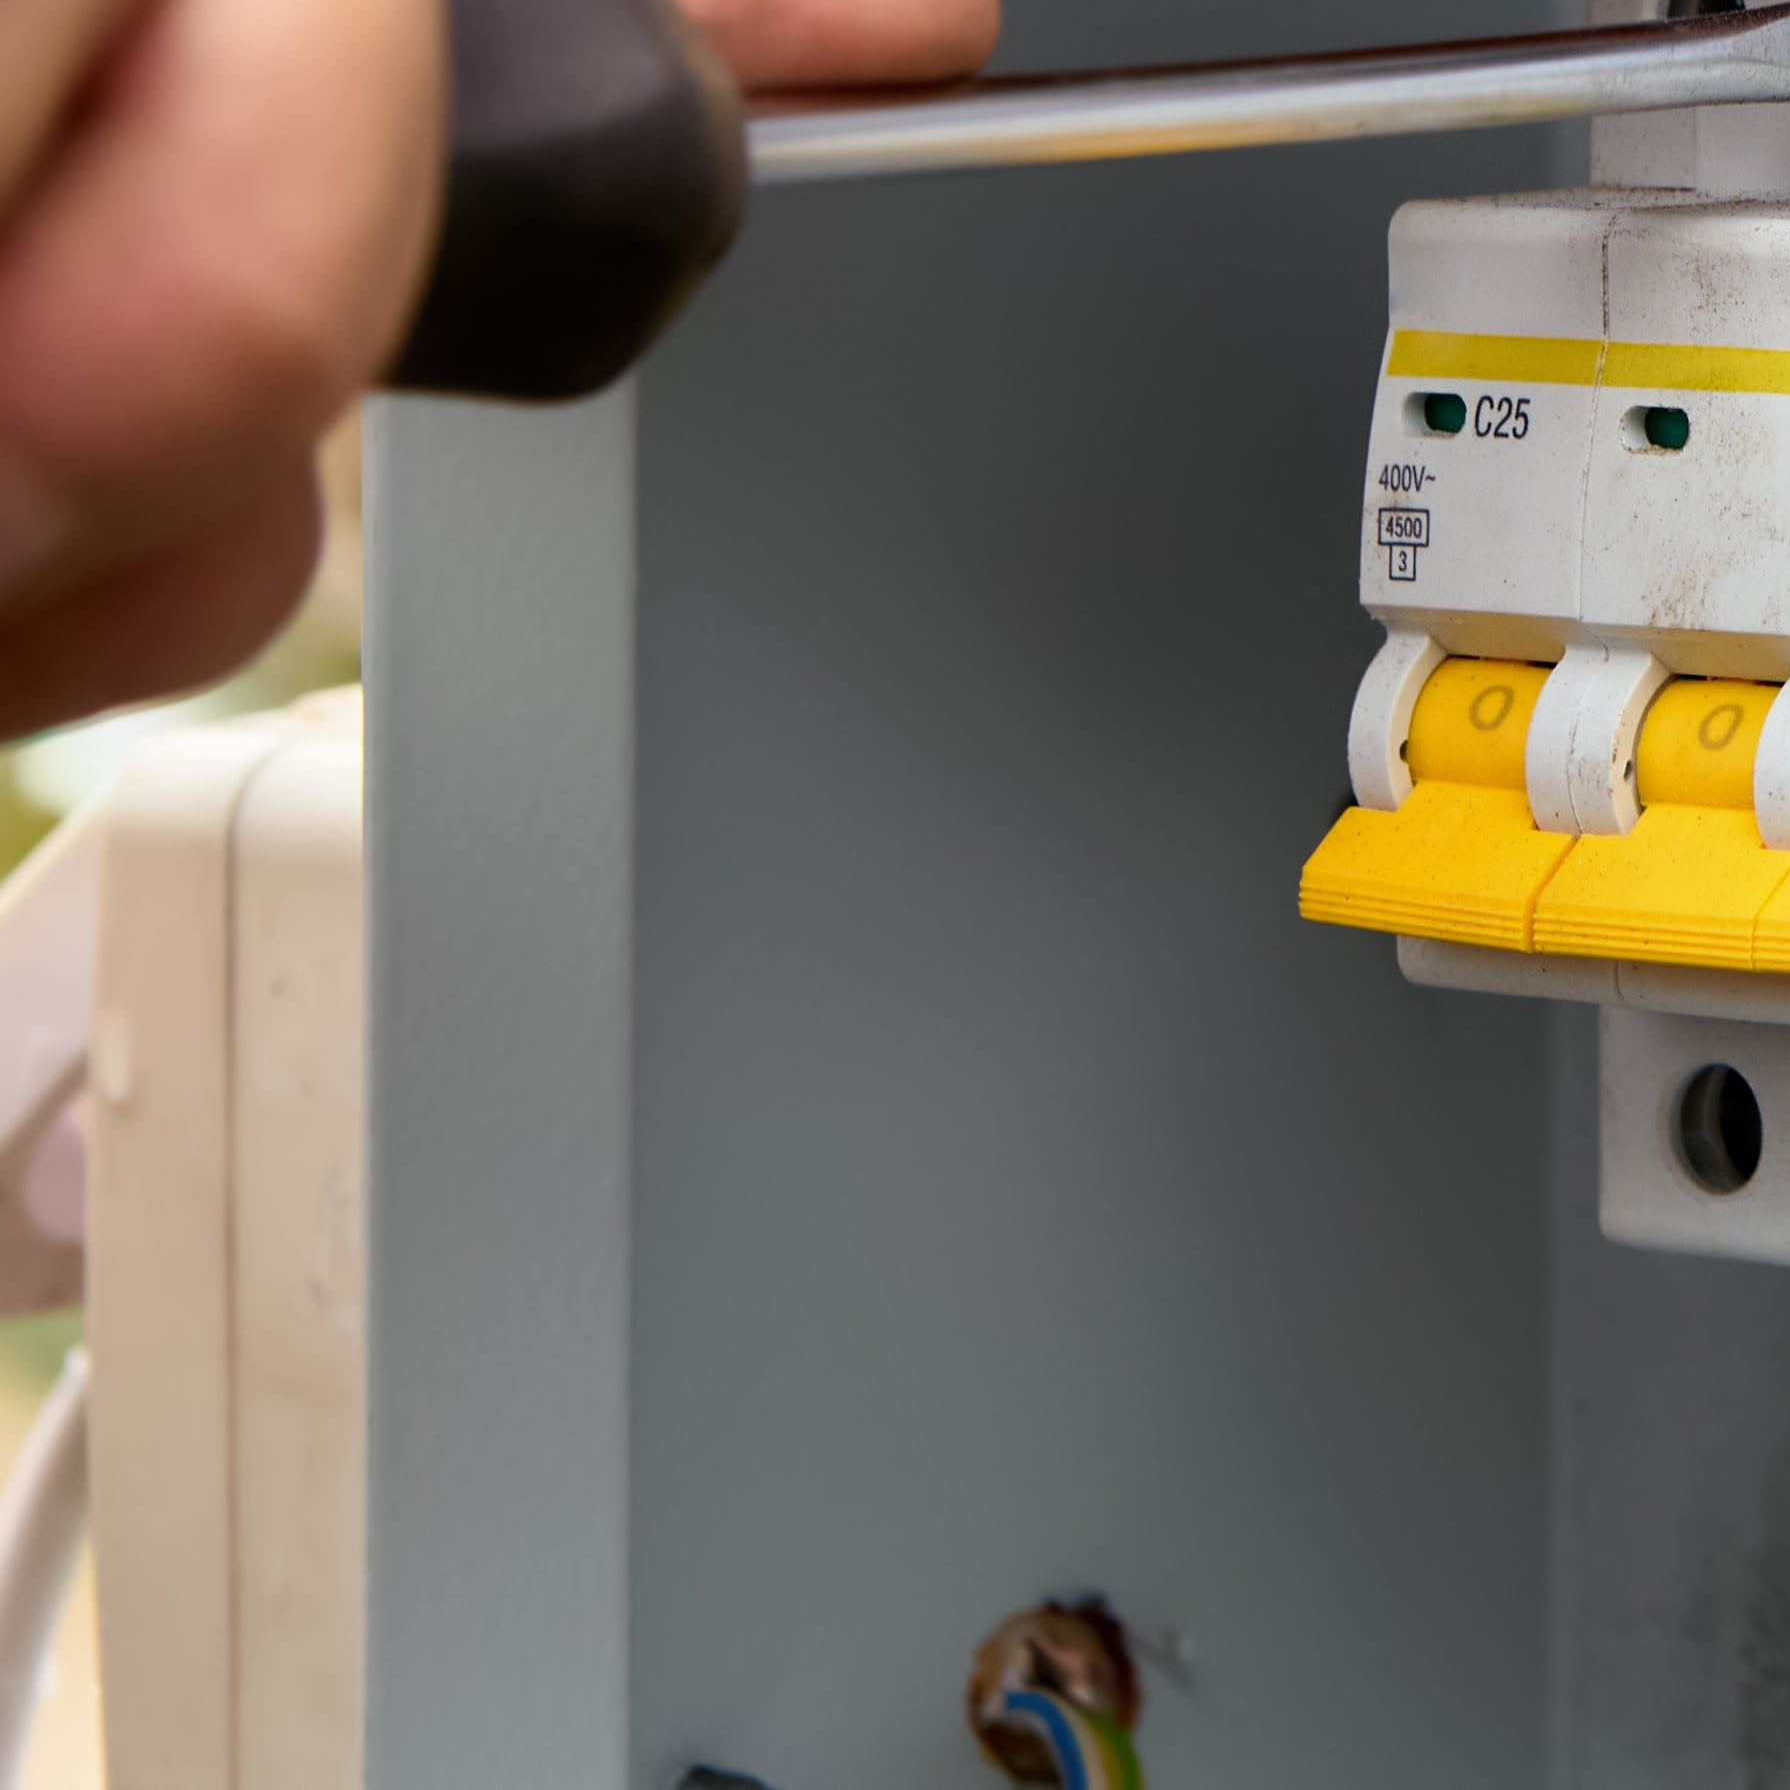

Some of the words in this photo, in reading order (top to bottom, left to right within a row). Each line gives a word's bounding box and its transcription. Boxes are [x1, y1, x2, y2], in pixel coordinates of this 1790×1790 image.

[1474, 394, 1532, 440] C25
[1385, 515, 1423, 540] 4500
[1398, 549, 1408, 573] 3
